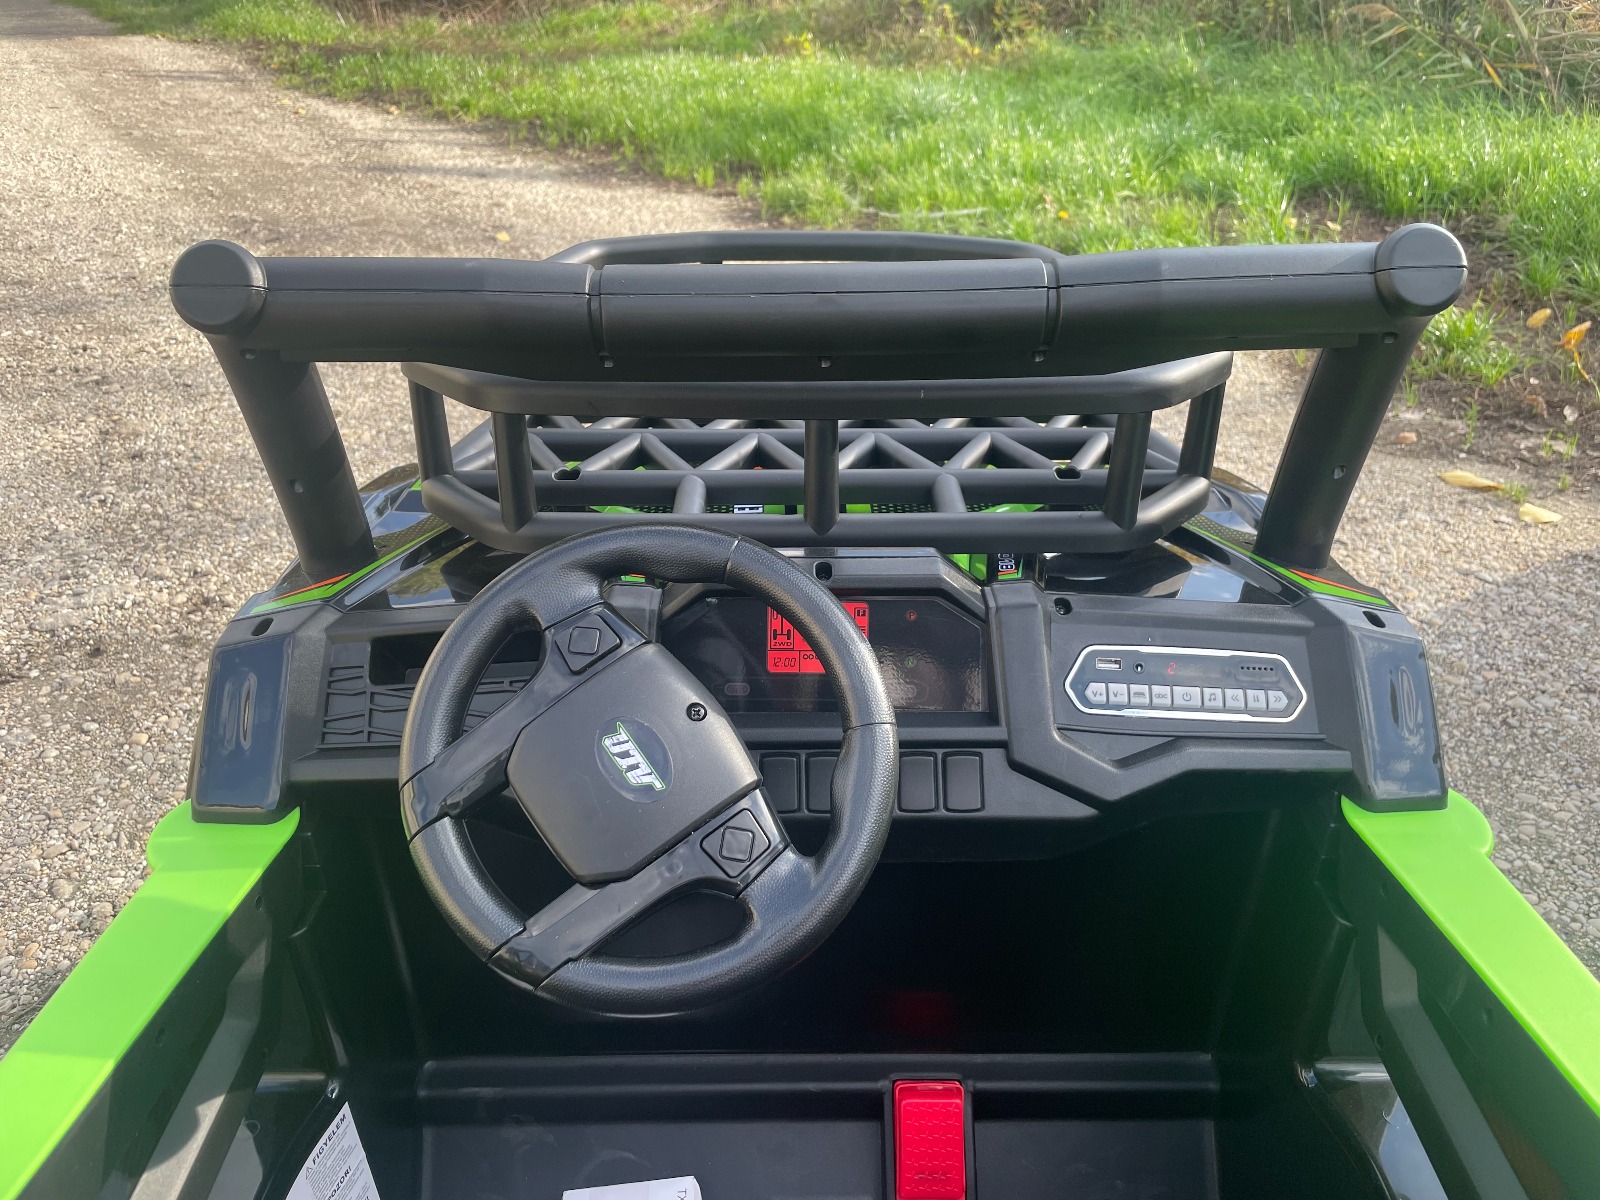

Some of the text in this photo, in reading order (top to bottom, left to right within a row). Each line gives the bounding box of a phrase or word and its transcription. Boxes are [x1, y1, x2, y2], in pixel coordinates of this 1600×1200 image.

[908, 611, 915, 619] P
[773, 657, 797, 668] 12:00
[602, 722, 665, 791] UTV
[312, 1113, 347, 1166] FIGYELEM
